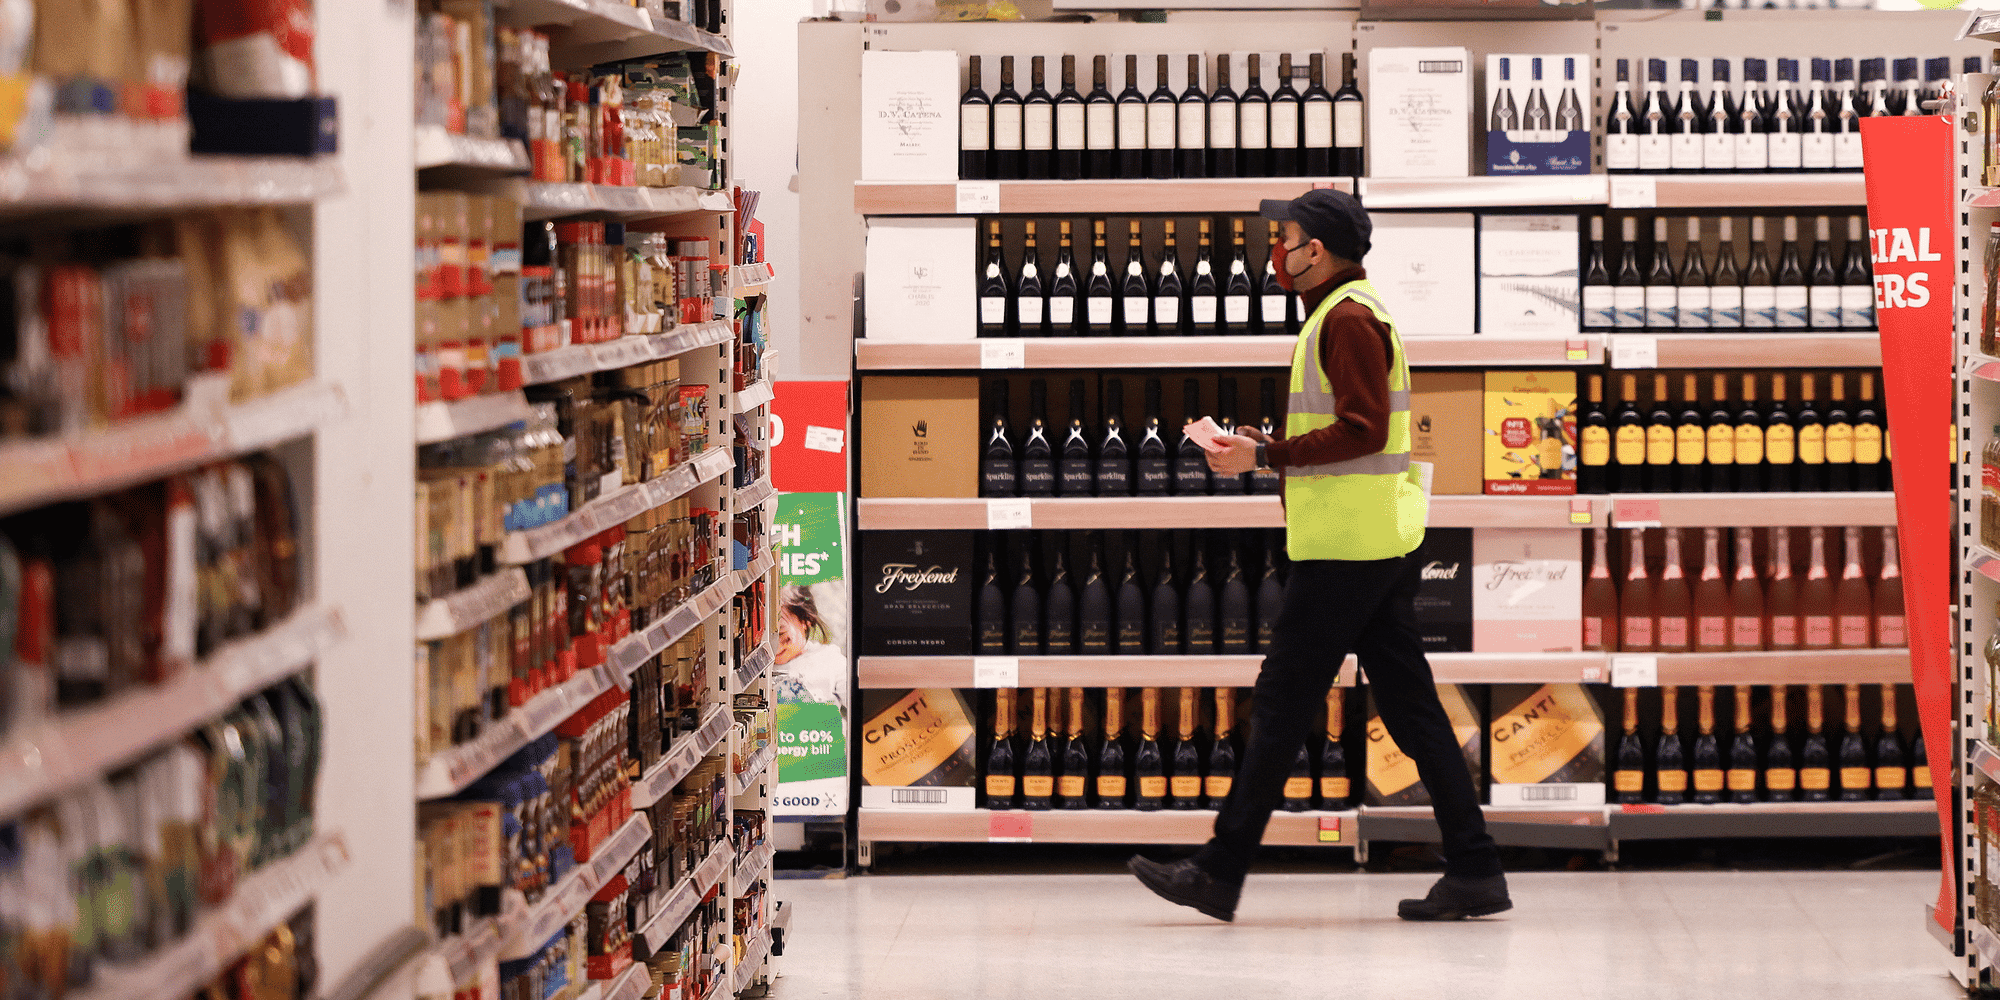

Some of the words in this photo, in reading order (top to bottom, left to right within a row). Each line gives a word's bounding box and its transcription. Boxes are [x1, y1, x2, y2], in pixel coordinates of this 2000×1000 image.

[878, 110, 900, 119] D.V.
[875, 563, 959, 594] Freixenet
[886, 638, 918, 646] CORDON
[919, 638, 946, 646] NEGRO
[864, 697, 928, 745] CANTI
[1494, 694, 1556, 743] CANTI
[779, 731, 795, 743] to
[798, 730, 834, 743] 60%
[782, 796, 820, 807] GOOD
